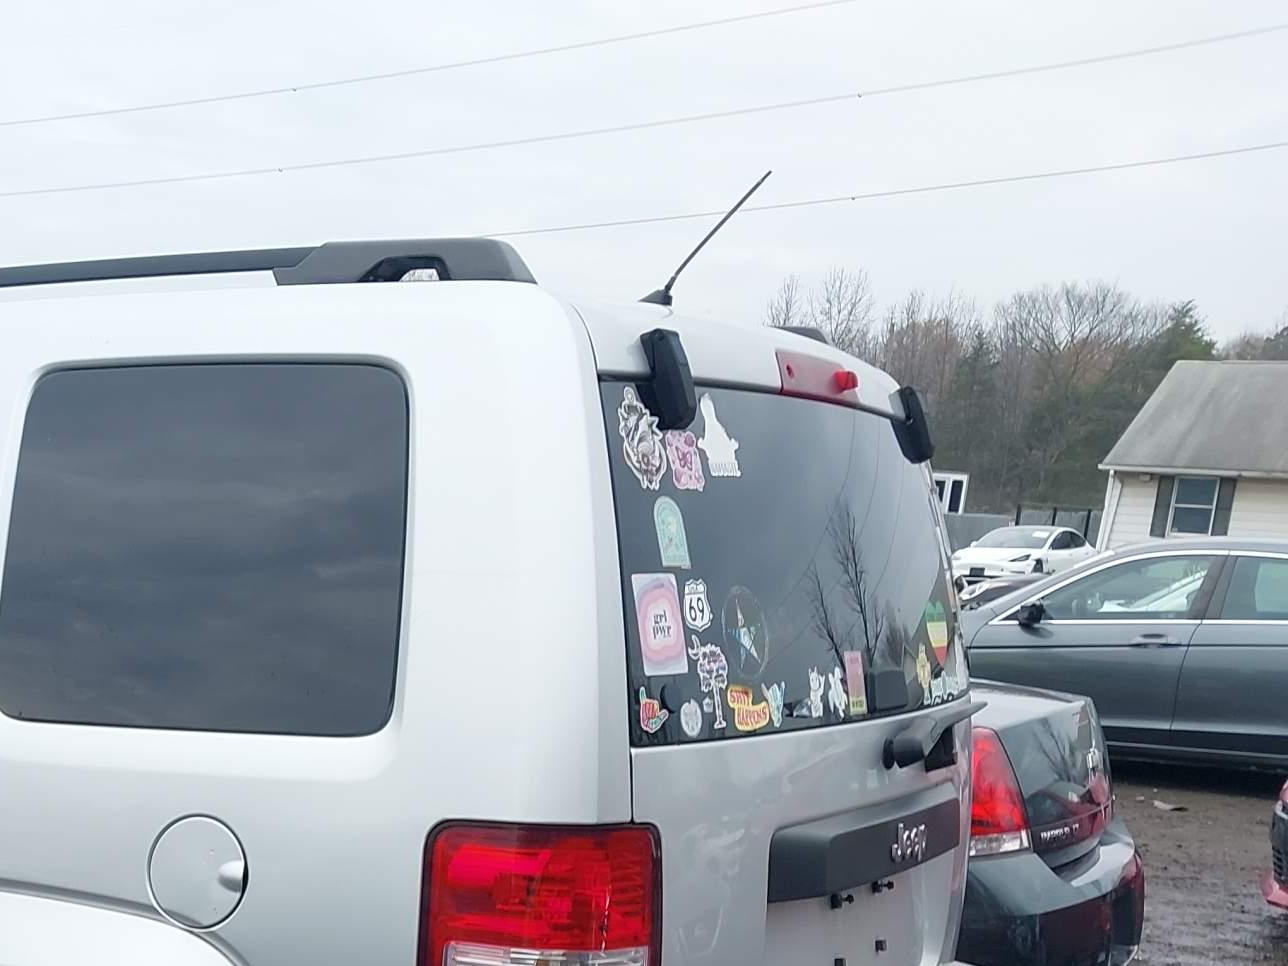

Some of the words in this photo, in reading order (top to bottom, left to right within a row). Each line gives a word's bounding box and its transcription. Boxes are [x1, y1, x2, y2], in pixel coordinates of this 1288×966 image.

[653, 609, 667, 624] grl
[689, 597, 705, 621] 69
[652, 625, 672, 639] pwr
[892, 823, 926, 861] Jeep
